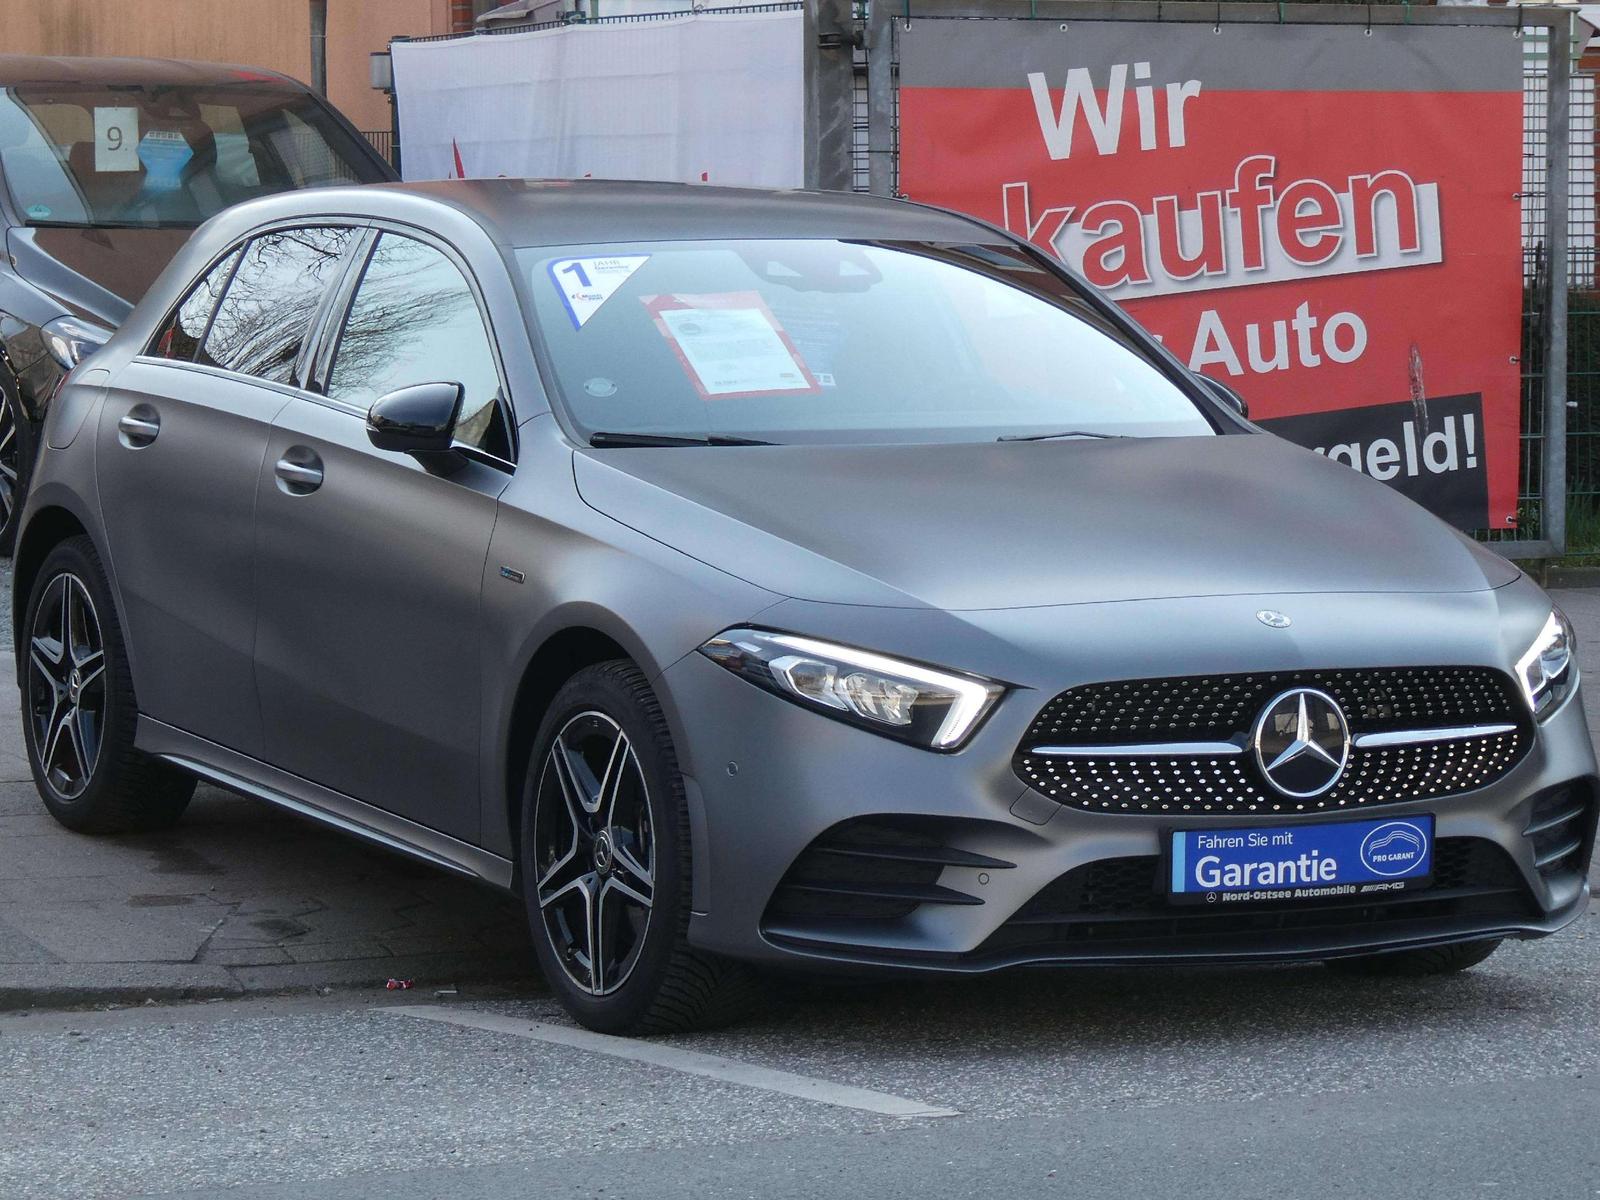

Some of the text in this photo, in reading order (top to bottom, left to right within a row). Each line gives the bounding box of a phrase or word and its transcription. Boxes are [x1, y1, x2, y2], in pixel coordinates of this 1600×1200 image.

[1027, 61, 1202, 161] Wir
[1002, 154, 1421, 290] kaufen
[562, 262, 592, 287] 1
[1188, 300, 1368, 376] Auto
[1197, 831, 1293, 849] Fahren Sie mit
[1195, 849, 1338, 888] Garantie
[1372, 851, 1415, 863] PRO GARANT
[1222, 884, 1357, 902] Nord-Ostsee Automobile
[1376, 881, 1405, 890] AMG
